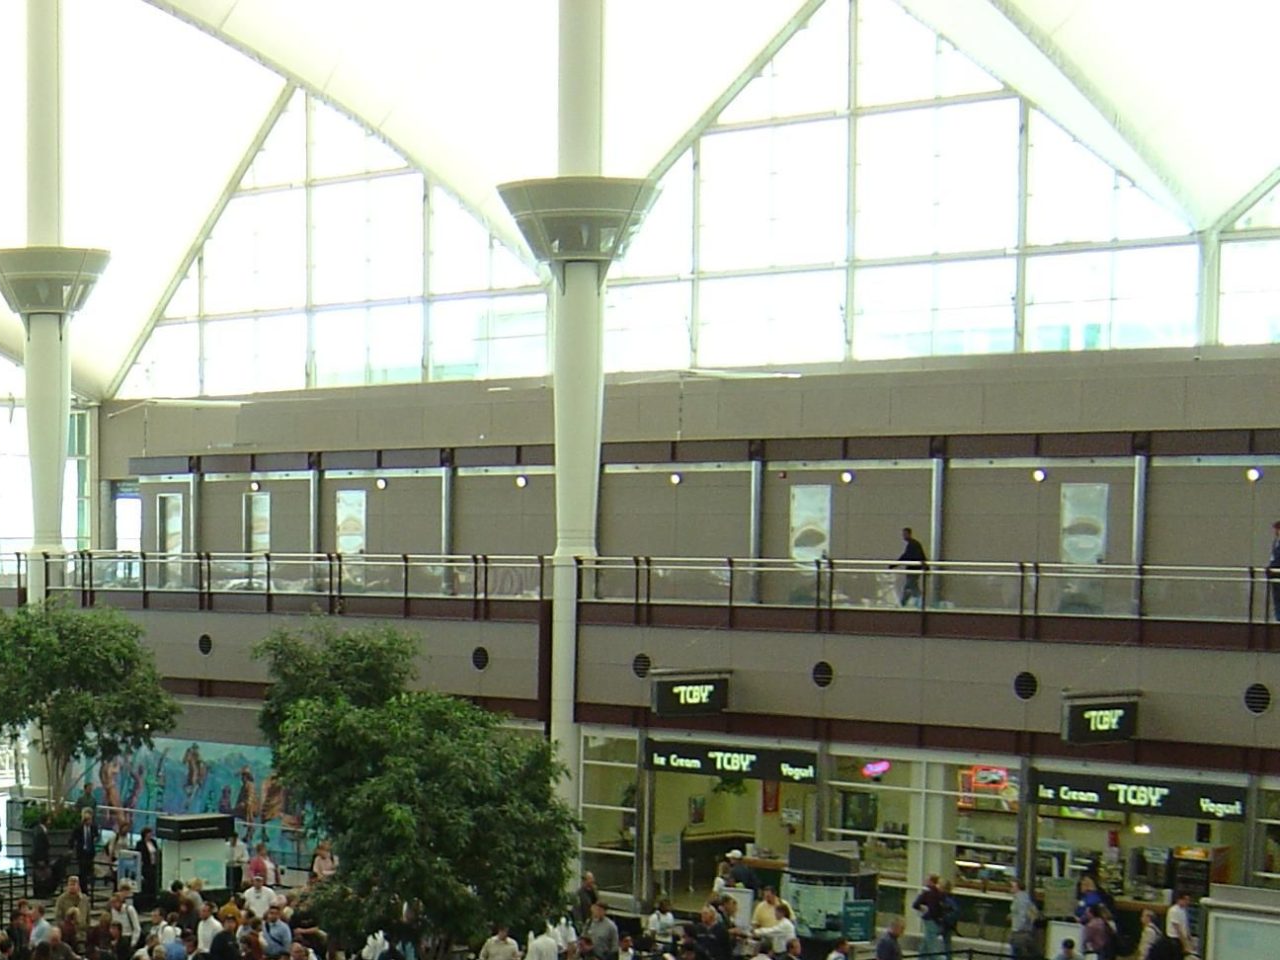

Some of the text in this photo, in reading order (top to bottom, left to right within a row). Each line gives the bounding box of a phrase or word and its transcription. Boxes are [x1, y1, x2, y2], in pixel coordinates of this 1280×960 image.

[670, 754, 701, 769] Cream
[780, 763, 814, 780] Yogurt
[1060, 786, 1099, 803] Cream
[1199, 798, 1242, 817] Yogurt
